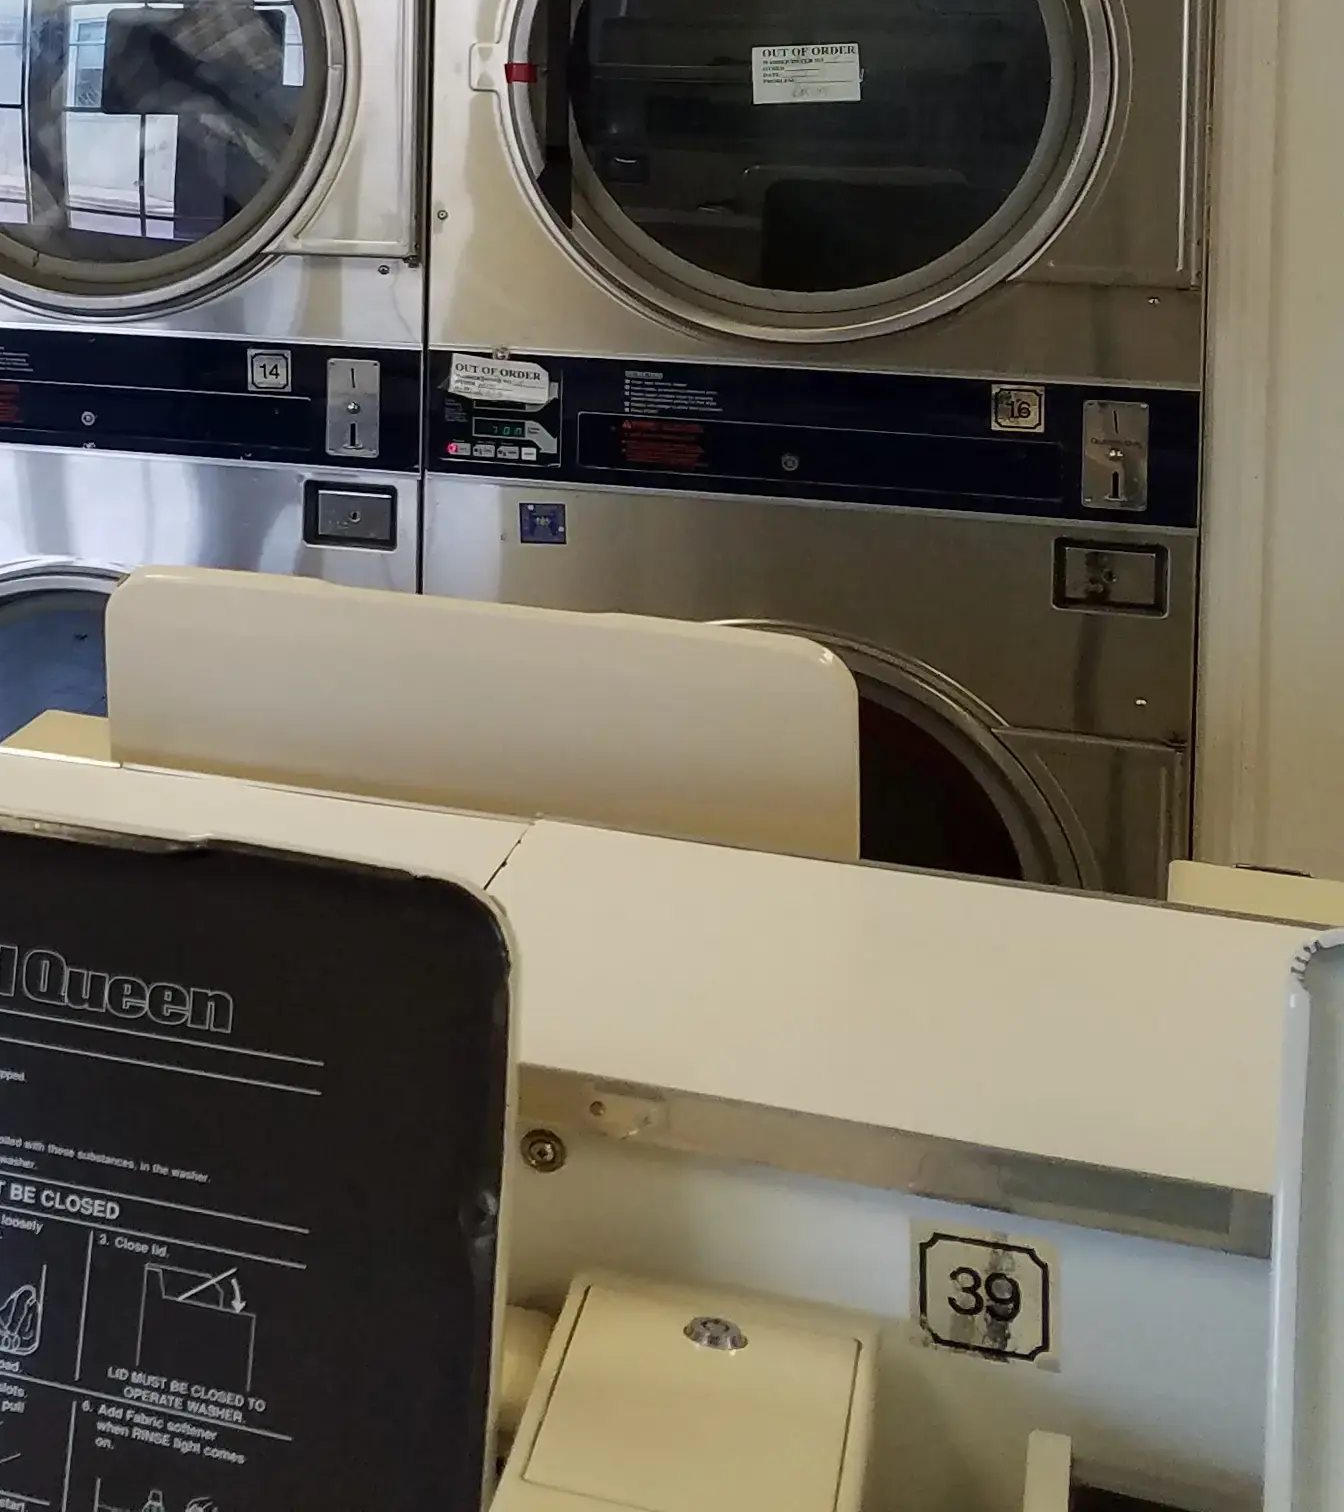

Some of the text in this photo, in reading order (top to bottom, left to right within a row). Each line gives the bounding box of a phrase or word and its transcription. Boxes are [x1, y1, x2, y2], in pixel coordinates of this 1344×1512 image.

[762, 46, 855, 58] OUT OF ORDER
[258, 363, 280, 380] 14
[455, 363, 541, 380] OUT OF ORDER
[1005, 401, 1031, 420] 16
[23, 950, 232, 1033] Queen
[10, 1187, 36, 1204] BE
[40, 1189, 121, 1220] CLOSED
[948, 1267, 1021, 1322] 39
[107, 1367, 266, 1412] LID MUST BE CLOSED TO
[124, 1387, 246, 1423] OPERATE WASHER.
